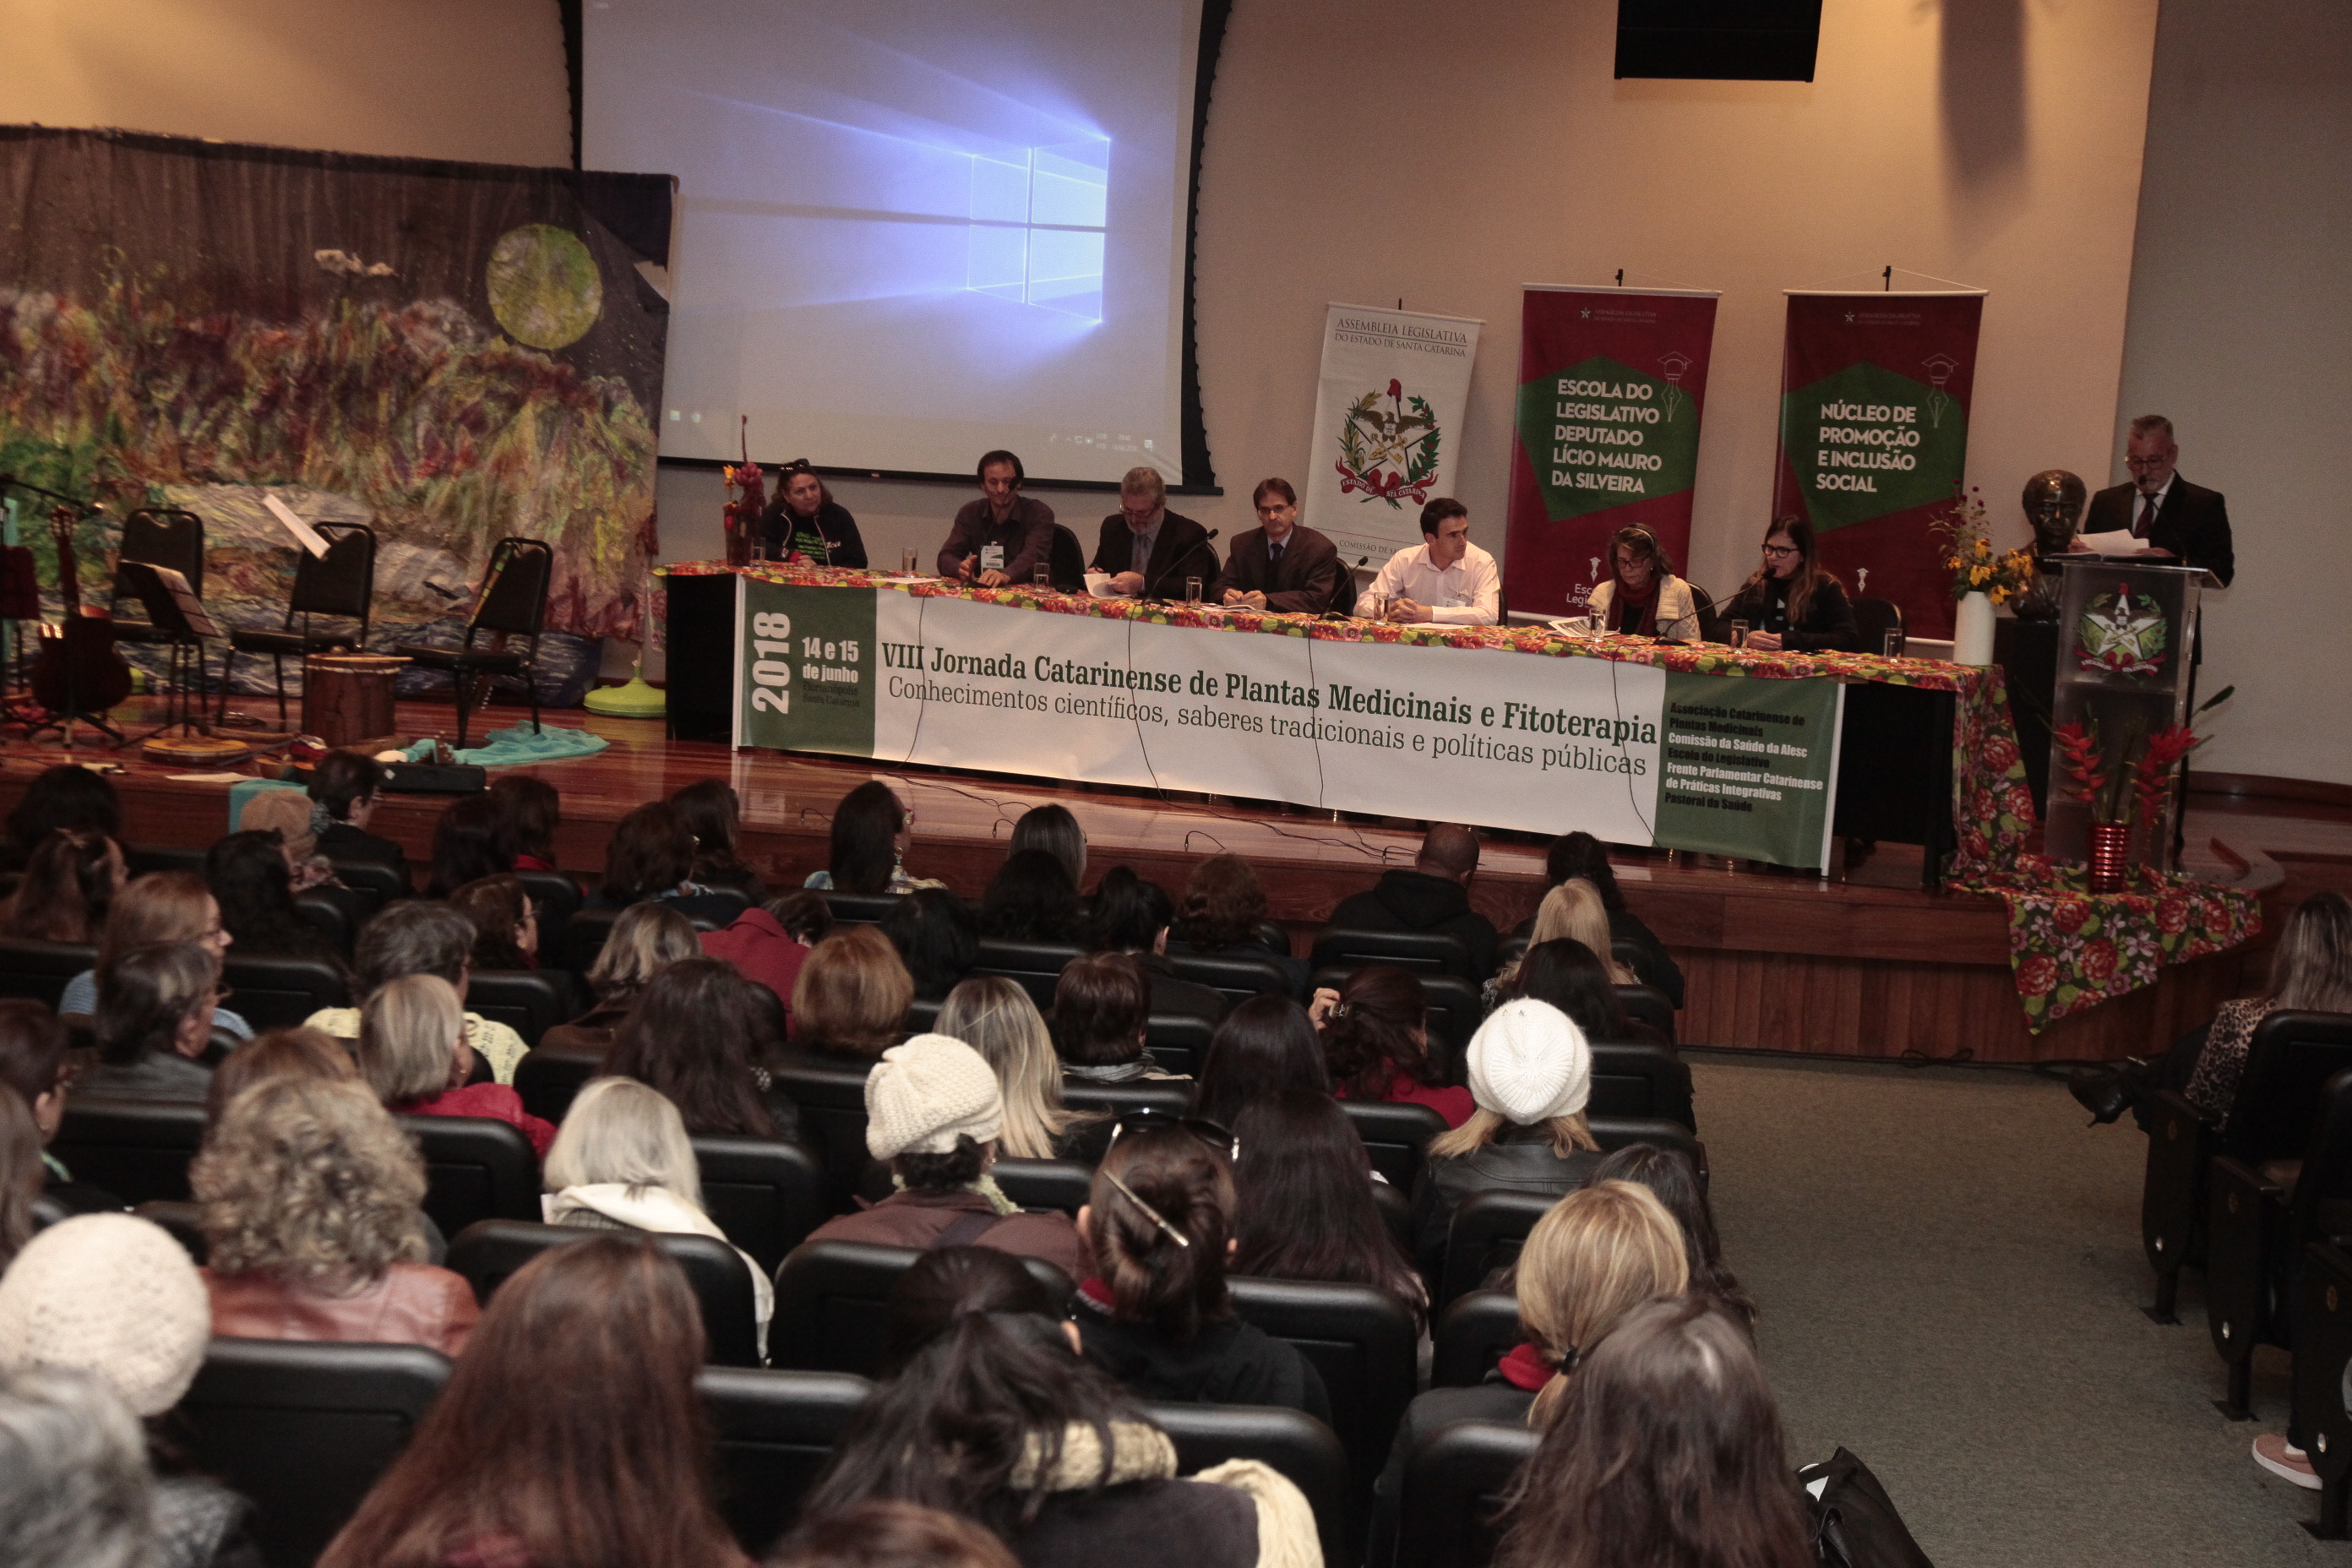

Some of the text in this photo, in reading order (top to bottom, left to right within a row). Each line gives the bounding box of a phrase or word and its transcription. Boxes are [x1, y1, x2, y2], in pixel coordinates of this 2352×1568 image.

[1337, 318, 1467, 343] ASSEMBLEIA LEGISLATIVA
[1335, 333, 1466, 357] DO ESTADO DE SANTA CATARINA
[1558, 379, 1652, 400] ESCOLA DO
[1556, 401, 1660, 424] LEGISLATIVO
[1821, 399, 1917, 422] NÚCLEO DE
[1554, 424, 1643, 446] DEPUTADO
[1819, 426, 1920, 450] PROMOÇÃO
[1553, 444, 1662, 471] LÍCIO MAURO
[1818, 449, 1916, 471] E INCLUSÃO
[1551, 470, 1645, 493] DA SILVEIRA
[1816, 473, 1877, 493] SOCIAL
[1339, 540, 1377, 552] COMISSÃO
[1575, 583, 1592, 595] Esc
[802, 636, 859, 662] 14 e 15
[751, 612, 791, 715] 2018
[803, 663, 858, 683] de junho
[881, 642, 1657, 747] VIII Jornada Catarinense de Plantas Medicinais e Fitoterapia
[889, 675, 1647, 776] Conhecimentos científicos, saberes tradicionais e políticas públicas
[1669, 702, 1805, 727] Associação Catarinense de
[1669, 718, 1763, 738] Plantas Medicinais
[1669, 732, 1808, 758] Comissão da Saúde da Alesc
[1668, 747, 1700, 760] Escola
[1716, 752, 1770, 769] Legislativo
[1667, 762, 1824, 791] Frente Parlamentar Catarinense
[1666, 777, 1782, 801] de Práticas Integrativas
[1665, 792, 1705, 808] Pastoral
[1722, 798, 1753, 813] Saúde
